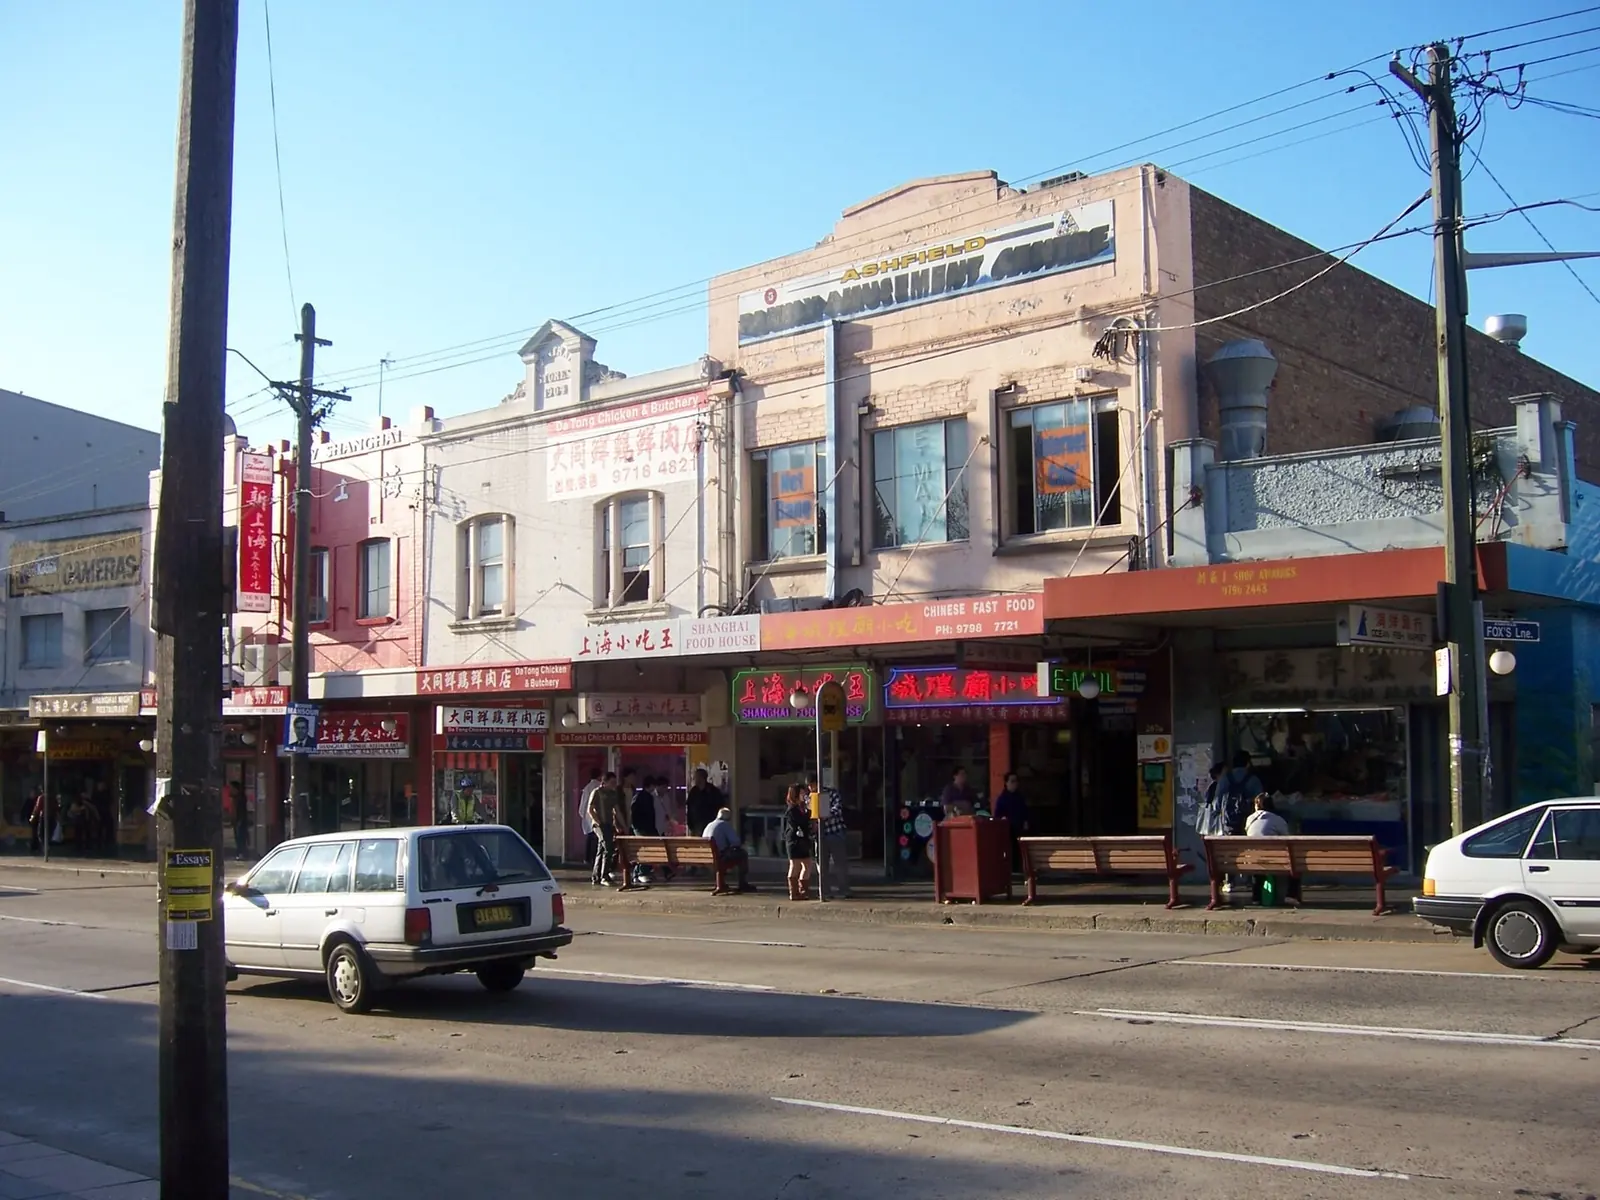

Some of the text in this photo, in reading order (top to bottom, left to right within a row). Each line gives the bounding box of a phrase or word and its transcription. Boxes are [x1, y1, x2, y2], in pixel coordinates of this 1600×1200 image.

[840, 236, 987, 284] ASHFIELD
[598, 406, 638, 425] Chicken
[642, 405, 648, 416] &
[651, 394, 699, 413] Butchery
[327, 430, 402, 458] SHANGHAI
[613, 464, 651, 483] 9716
[658, 456, 696, 474] 4821
[64, 554, 138, 585] CAMERAS
[924, 598, 1035, 617] CHINESE FAST FOOD
[692, 621, 749, 634] SHANGHAI
[936, 621, 1019, 635] PH: 9798 7721
[1486, 626, 1534, 638] FOX'S Lne.
[578, 628, 673, 655] 上海小吃王
[686, 634, 756, 649] FOOD HOUSE
[541, 665, 567, 675] Chicken
[525, 678, 559, 689] & Butchery
[1054, 669, 1115, 692] E-MIL
[743, 707, 816, 718] SHANGHAI FOO
[588, 733, 614, 742] Chicken
[622, 733, 653, 743] Butchery
[176, 853, 210, 866] Essays
